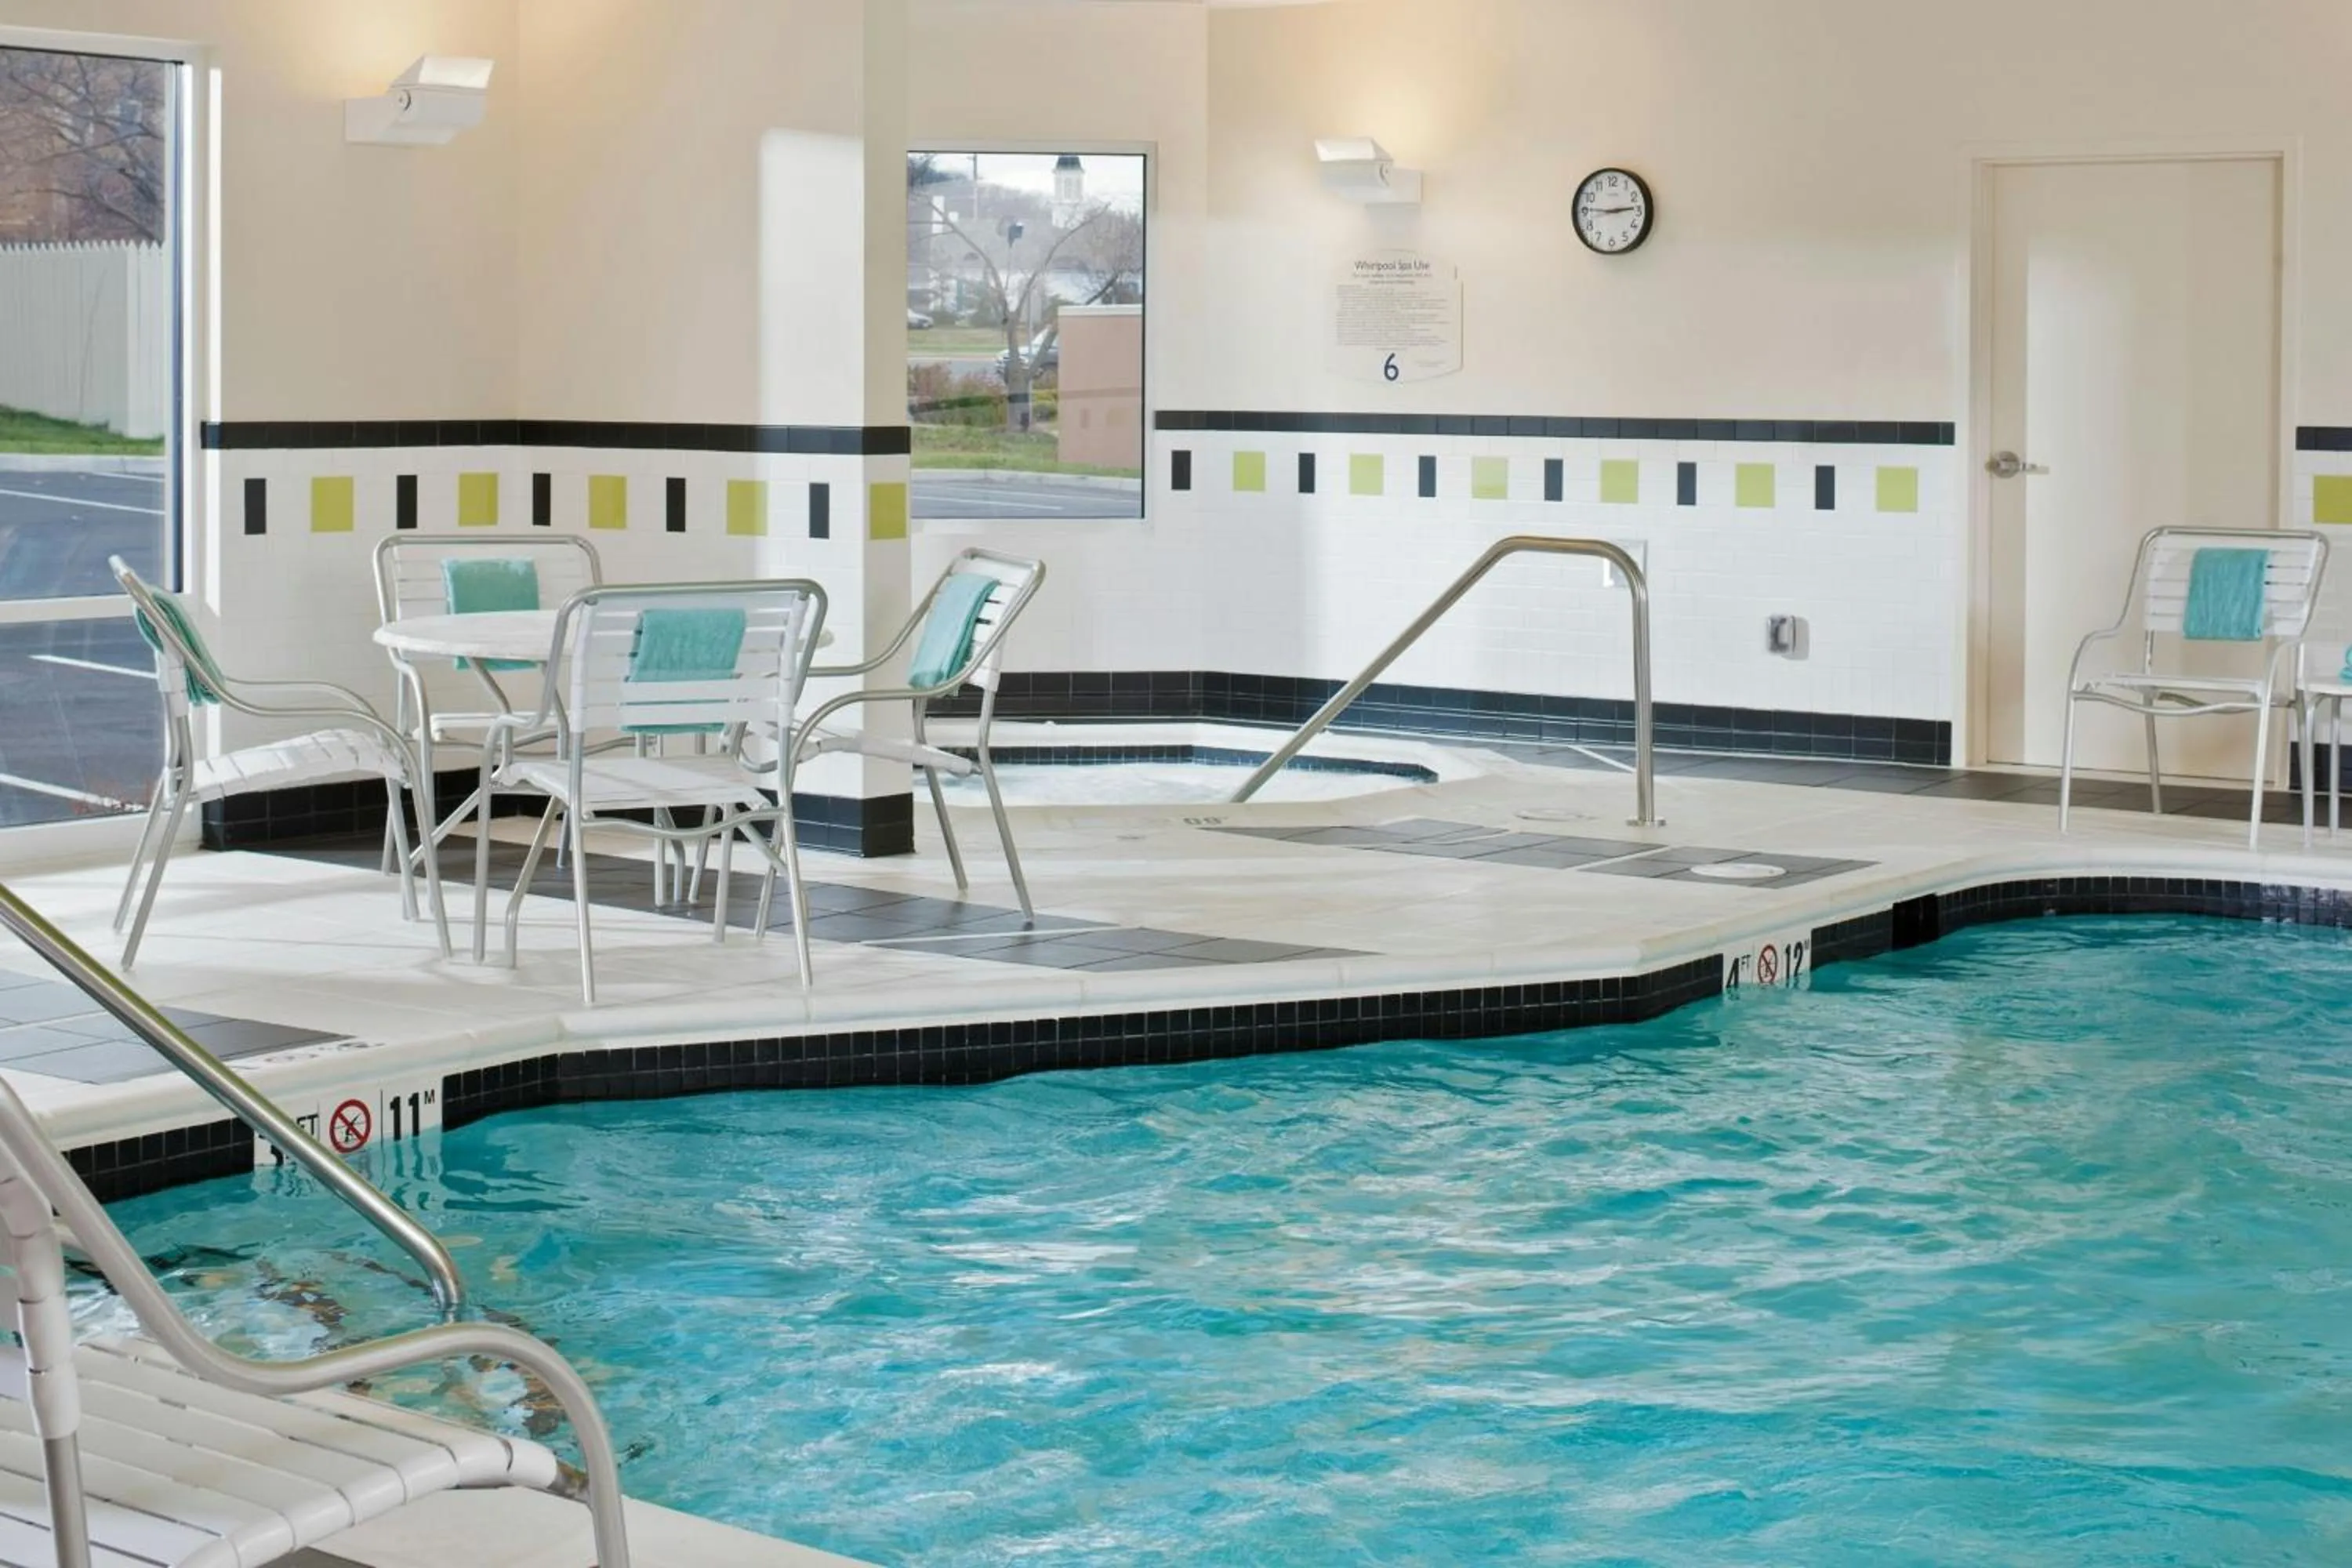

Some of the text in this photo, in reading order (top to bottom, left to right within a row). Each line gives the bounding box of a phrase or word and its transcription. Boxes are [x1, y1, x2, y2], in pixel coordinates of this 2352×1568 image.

[1595, 180, 1603, 191] 11
[1607, 176, 1618, 187] 12
[1624, 179, 1628, 191] 1
[1585, 192, 1595, 203] 10
[1631, 191, 1638, 202] 2
[1581, 206, 1588, 216] 9
[1636, 205, 1642, 216] 3
[1587, 220, 1593, 230] 8
[1630, 219, 1638, 230] 4
[1595, 231, 1602, 241] 7
[1608, 237, 1615, 246] 6
[1621, 231, 1628, 241] 5
[1354, 260, 1430, 271] Whirlpool Spa Use
[1384, 352, 1399, 381] 6
[424, 1089, 435, 1105] M
